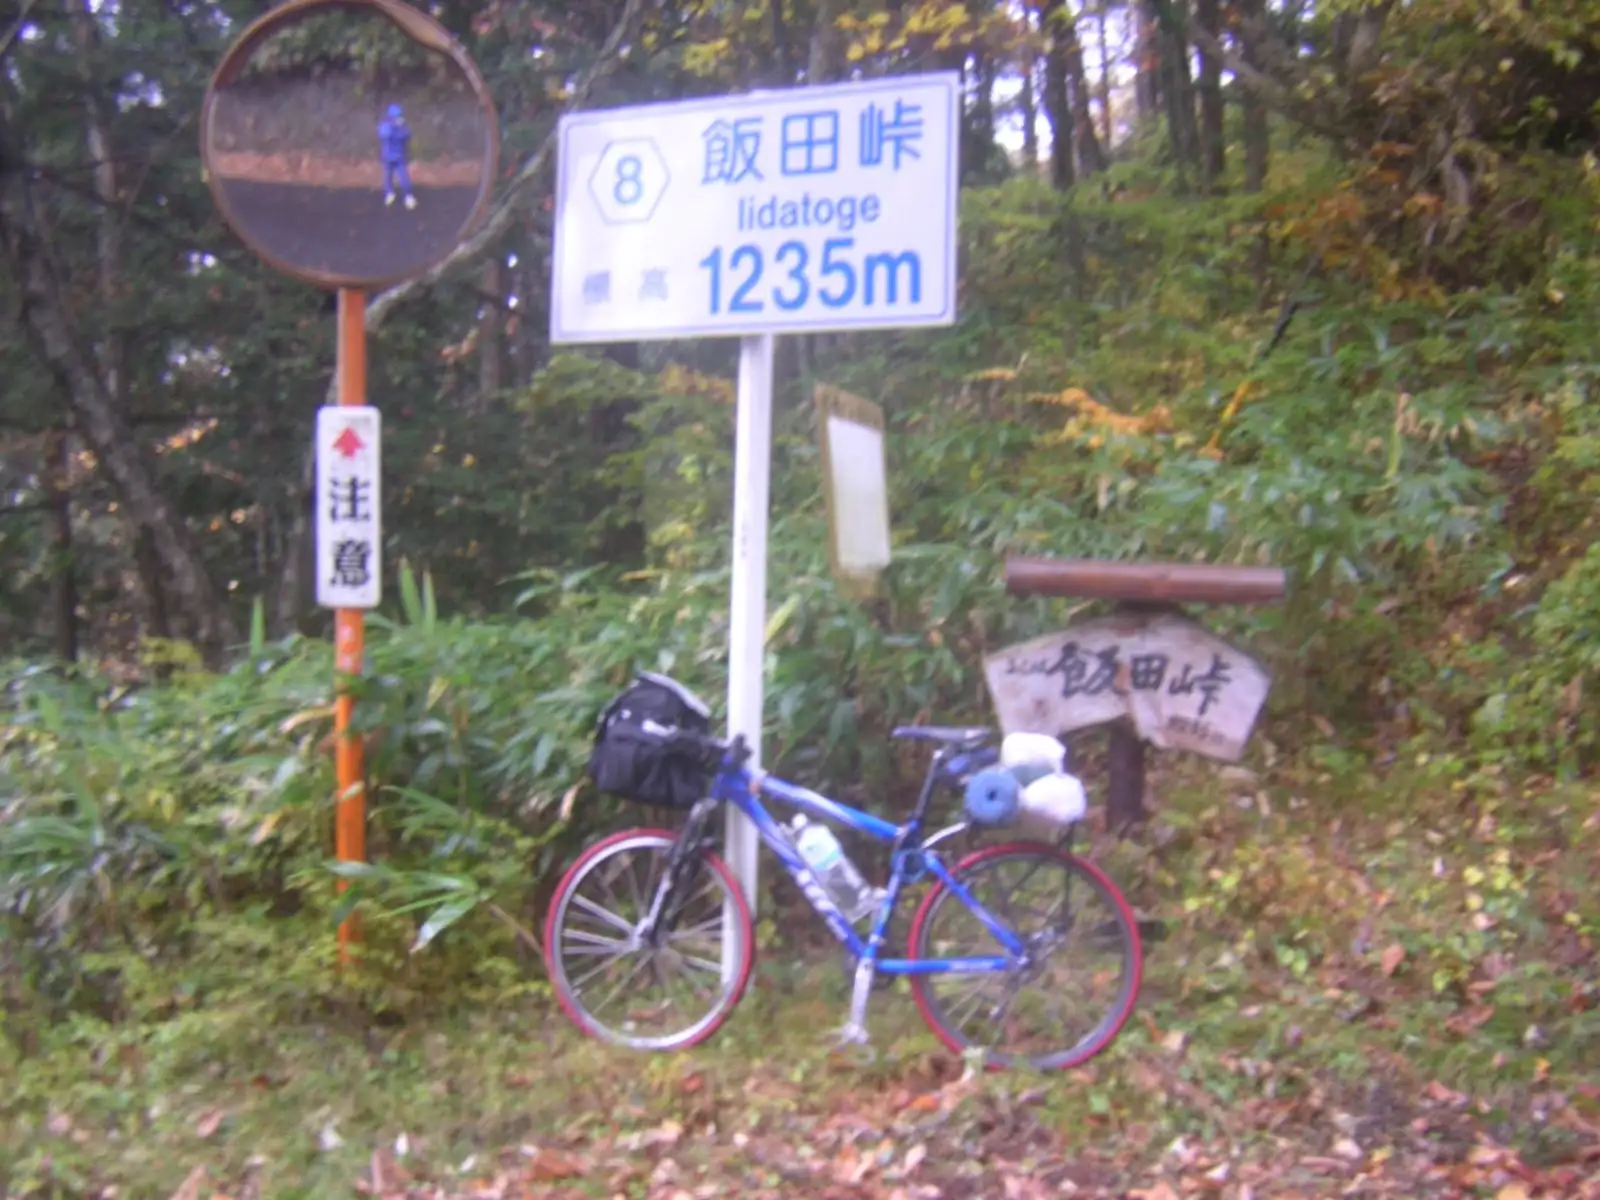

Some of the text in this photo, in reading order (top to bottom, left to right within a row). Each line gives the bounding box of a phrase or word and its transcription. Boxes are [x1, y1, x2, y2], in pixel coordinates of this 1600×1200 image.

[700, 97, 924, 186] 飯田峠
[613, 154, 643, 206] 8
[738, 193, 881, 232] Iidatoge
[699, 237, 922, 315] 1235m
[329, 476, 371, 588] 注意
[1046, 641, 1232, 716] 飯田峠
